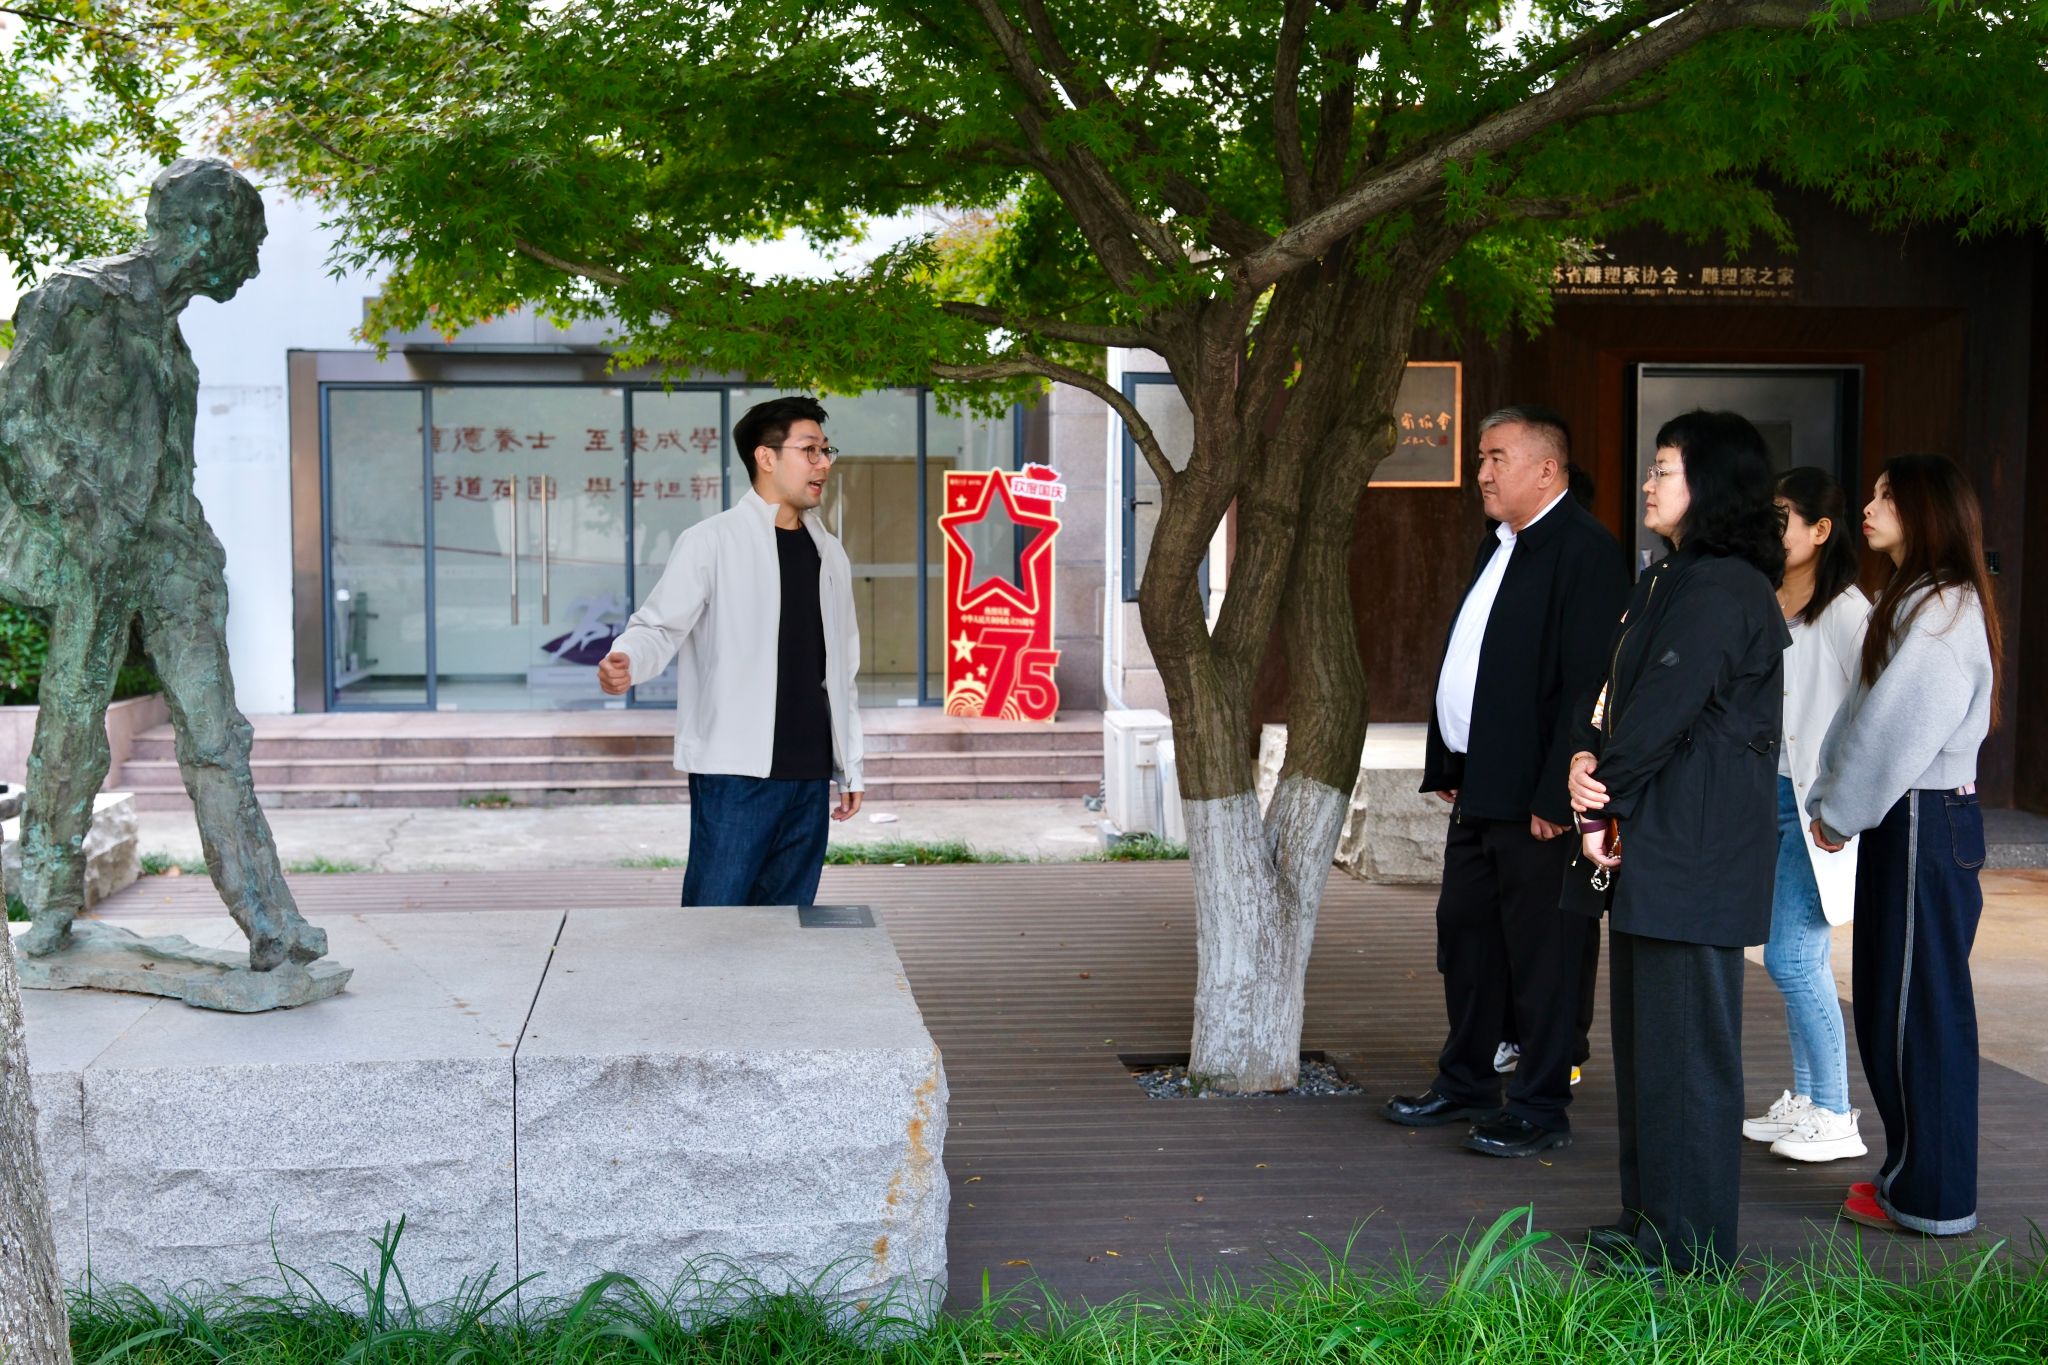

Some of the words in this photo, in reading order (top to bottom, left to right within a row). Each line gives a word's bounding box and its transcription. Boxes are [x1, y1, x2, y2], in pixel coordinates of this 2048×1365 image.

[1538, 265, 1678, 285] 苏省雕塑家协会
[1701, 266, 1795, 285] 雕塑家之家
[1570, 286, 1620, 295] Association
[1740, 287, 1752, 297] for
[1754, 288, 1793, 298] Sculpor
[1014, 480, 1063, 499] 欢度国庆
[977, 628, 1061, 721] 75
